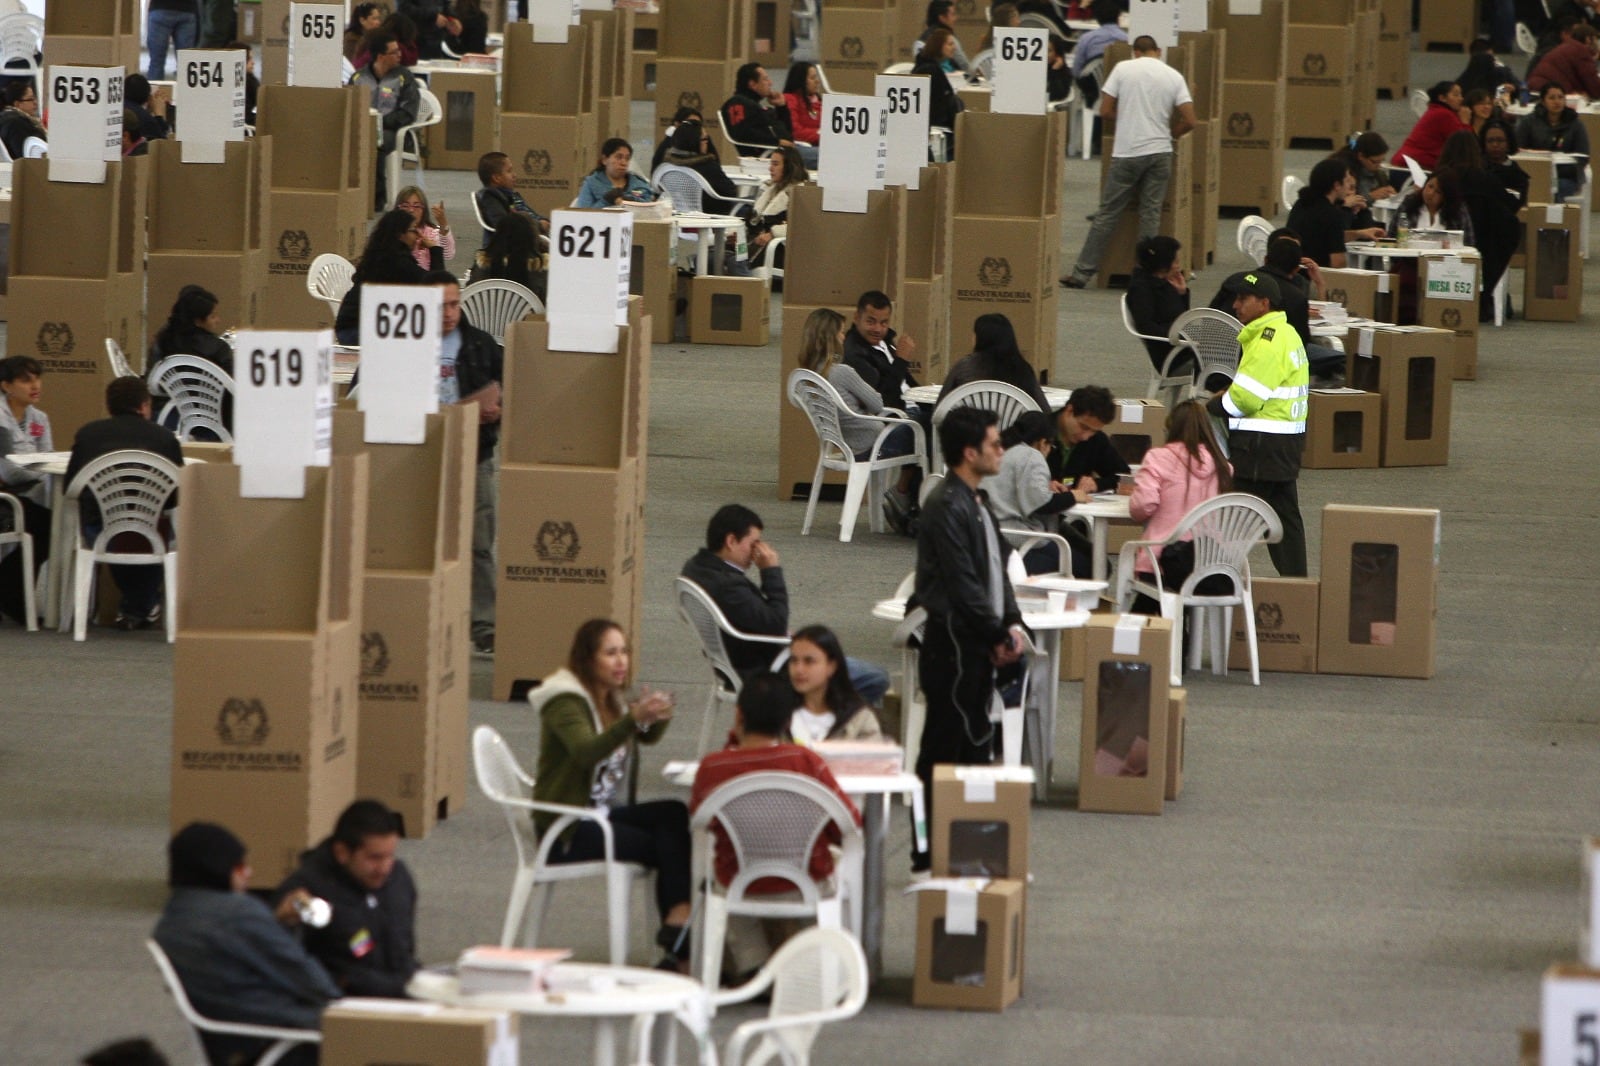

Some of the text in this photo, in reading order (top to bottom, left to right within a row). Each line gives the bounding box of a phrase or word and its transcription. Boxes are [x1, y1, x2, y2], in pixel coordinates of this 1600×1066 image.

[302, 14, 335, 39] 655
[1002, 36, 1043, 62] 652
[187, 61, 224, 88] 654
[54, 75, 100, 104] 653
[887, 87, 921, 114] 651
[832, 106, 870, 135] 650
[558, 225, 611, 259] 621
[1429, 280, 1471, 294] MESA 652
[376, 302, 426, 339] 620
[250, 348, 303, 388] 619
[505, 566, 607, 578] REGISTRADURÍA
[1577, 1013, 1600, 1066] 5
